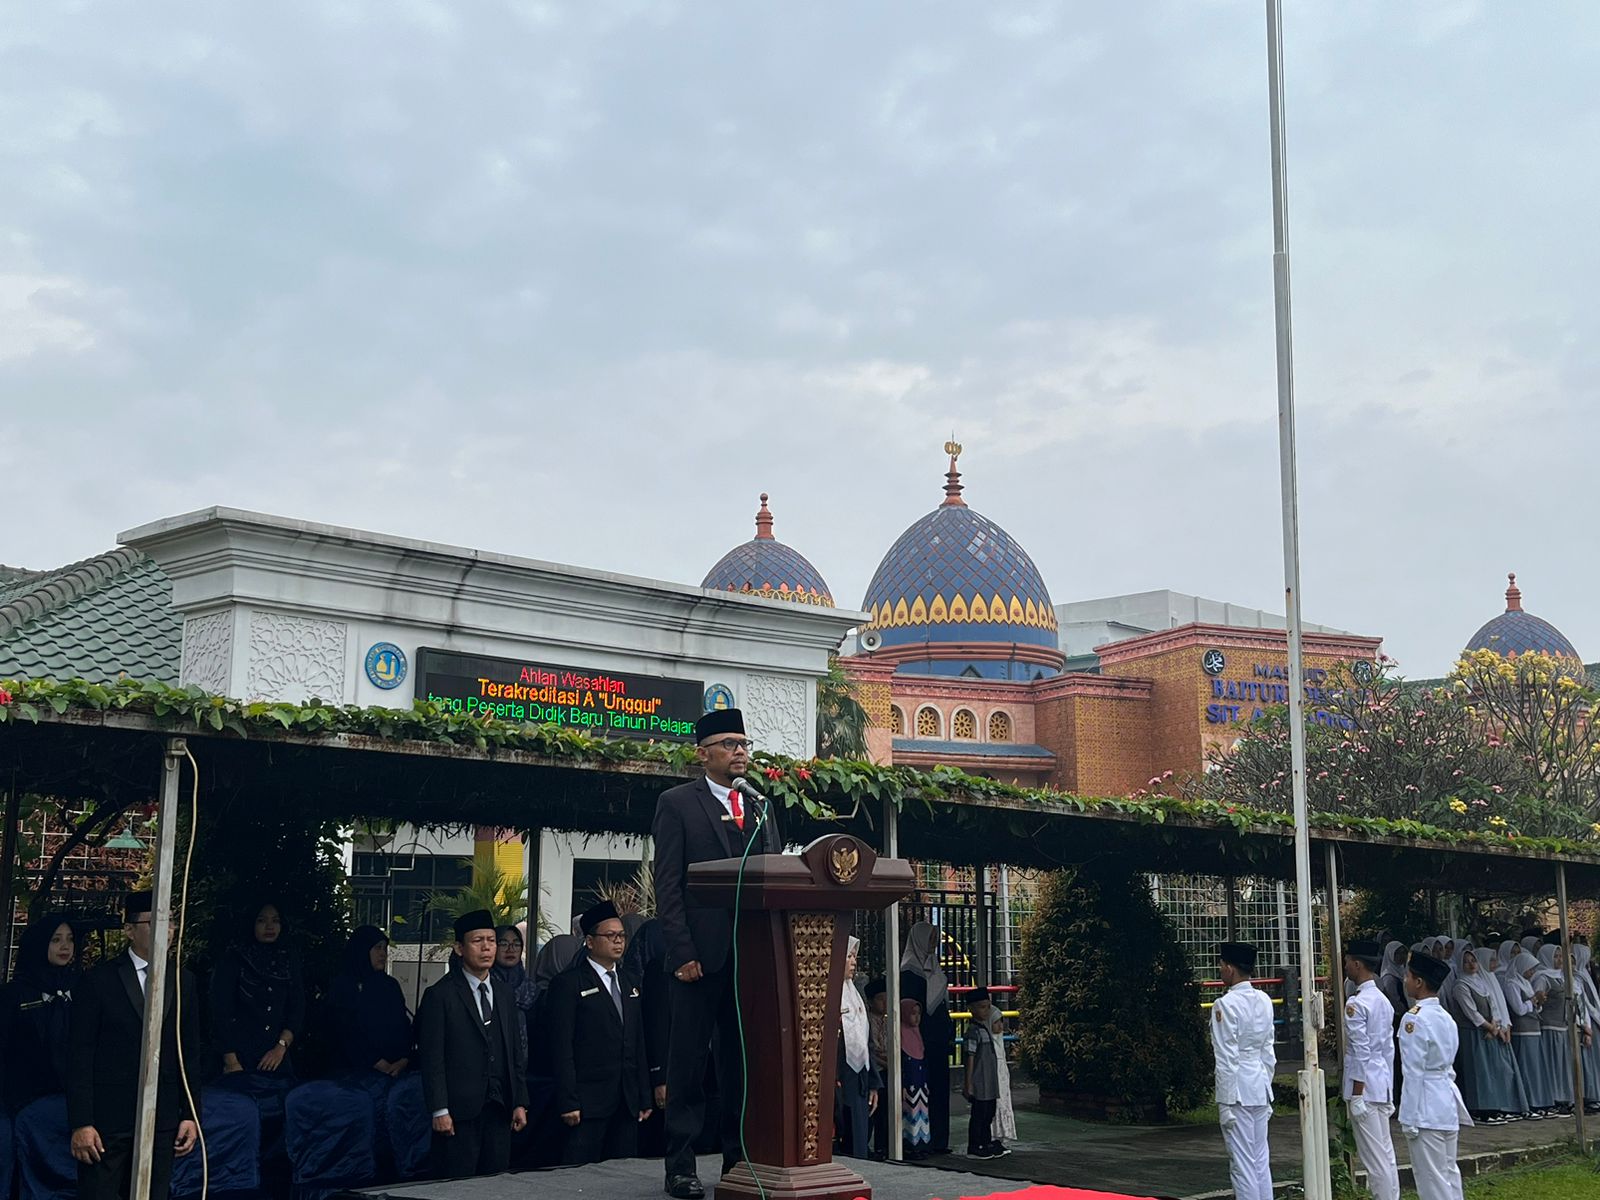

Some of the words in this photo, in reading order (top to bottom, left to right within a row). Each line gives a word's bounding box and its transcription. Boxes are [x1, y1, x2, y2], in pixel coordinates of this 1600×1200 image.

[478, 678, 580, 706] Terakreditasi
[583, 690, 595, 708] A
[599, 692, 661, 714] "Unggul"
[520, 666, 557, 686] Ahlan
[561, 671, 625, 695] Wasahlan
[467, 697, 524, 718] Peserta
[529, 703, 566, 726] Didik
[570, 707, 603, 726] Baru
[607, 711, 646, 730] Tahun
[1206, 703, 1240, 724] SIT
